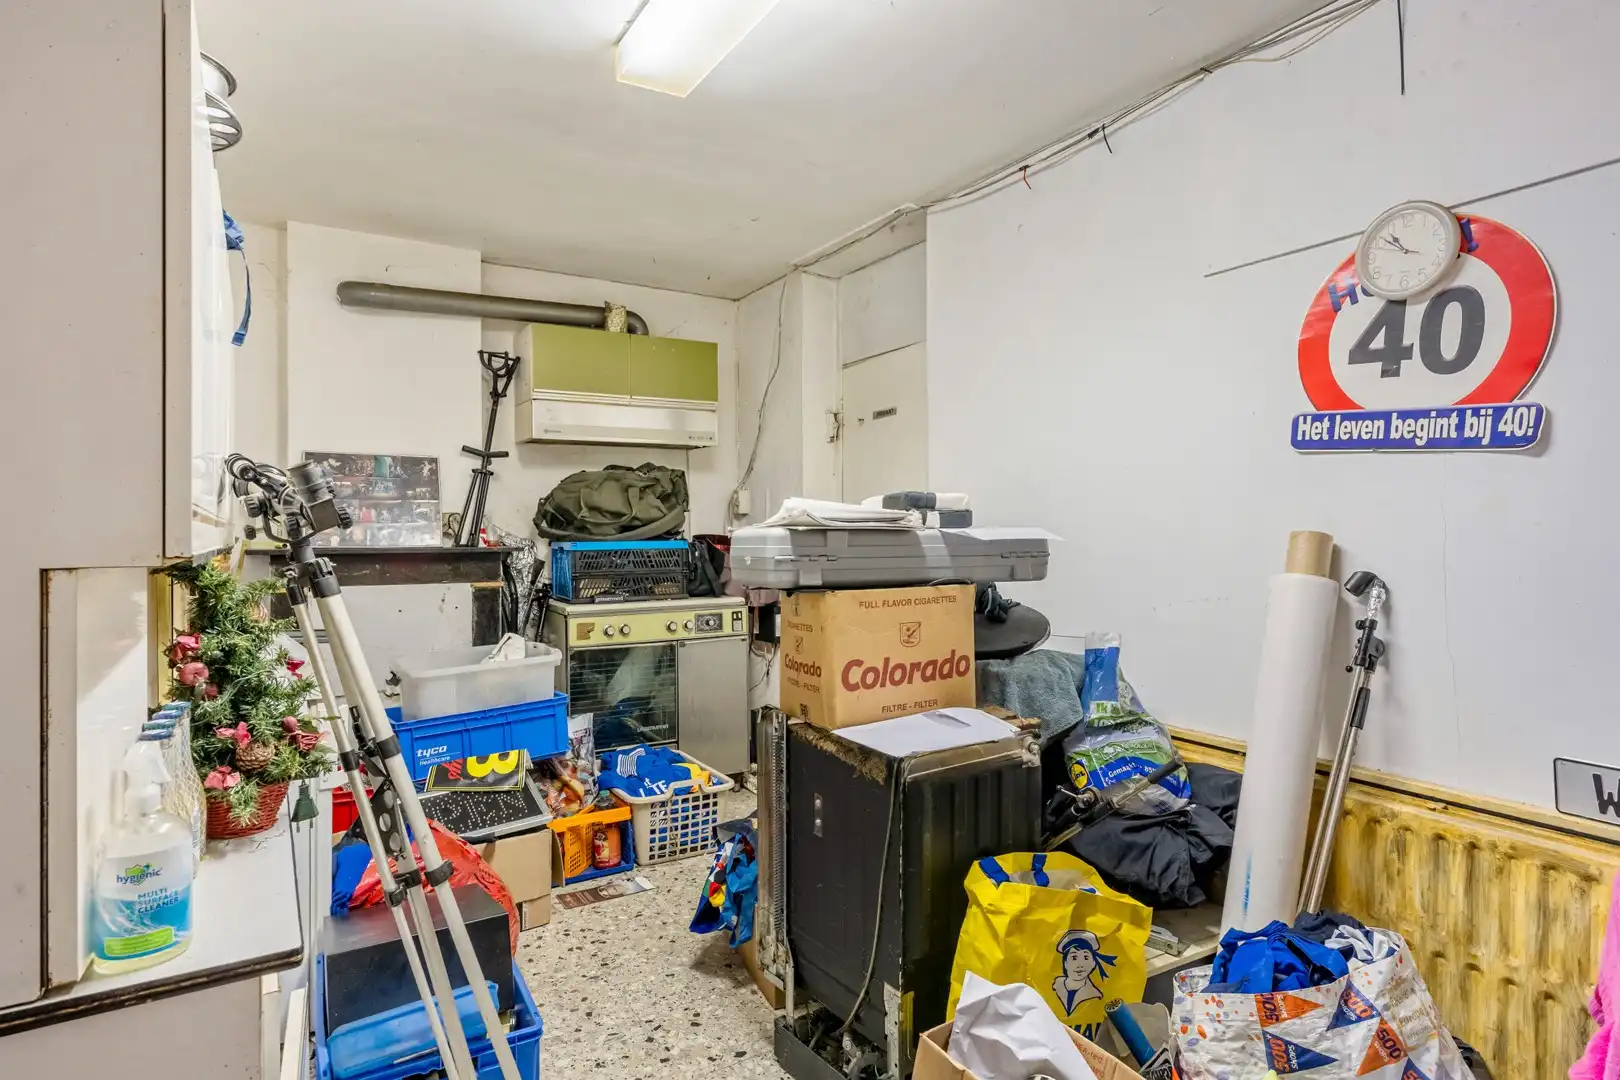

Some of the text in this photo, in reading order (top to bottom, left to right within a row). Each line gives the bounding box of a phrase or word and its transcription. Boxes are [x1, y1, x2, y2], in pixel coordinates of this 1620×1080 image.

[1348, 285, 1485, 379] 40
[1297, 406, 1537, 446] Het leven begint bij 40!
[859, 595, 957, 610] FULL FLAVOR CIGARETTES
[784, 654, 822, 677] Colorado
[841, 649, 970, 692] Colorado
[882, 703, 907, 714] FILTRE
[914, 699, 938, 710] FILTER
[416, 745, 447, 757] tyco
[419, 756, 451, 766] Healthcare
[116, 867, 162, 885] hygienic
[138, 888, 168, 899] MULTI
[138, 891, 179, 906] SURFACE
[138, 896, 179, 914] CLEANER
[1287, 1045, 1298, 1070] SHOPS
